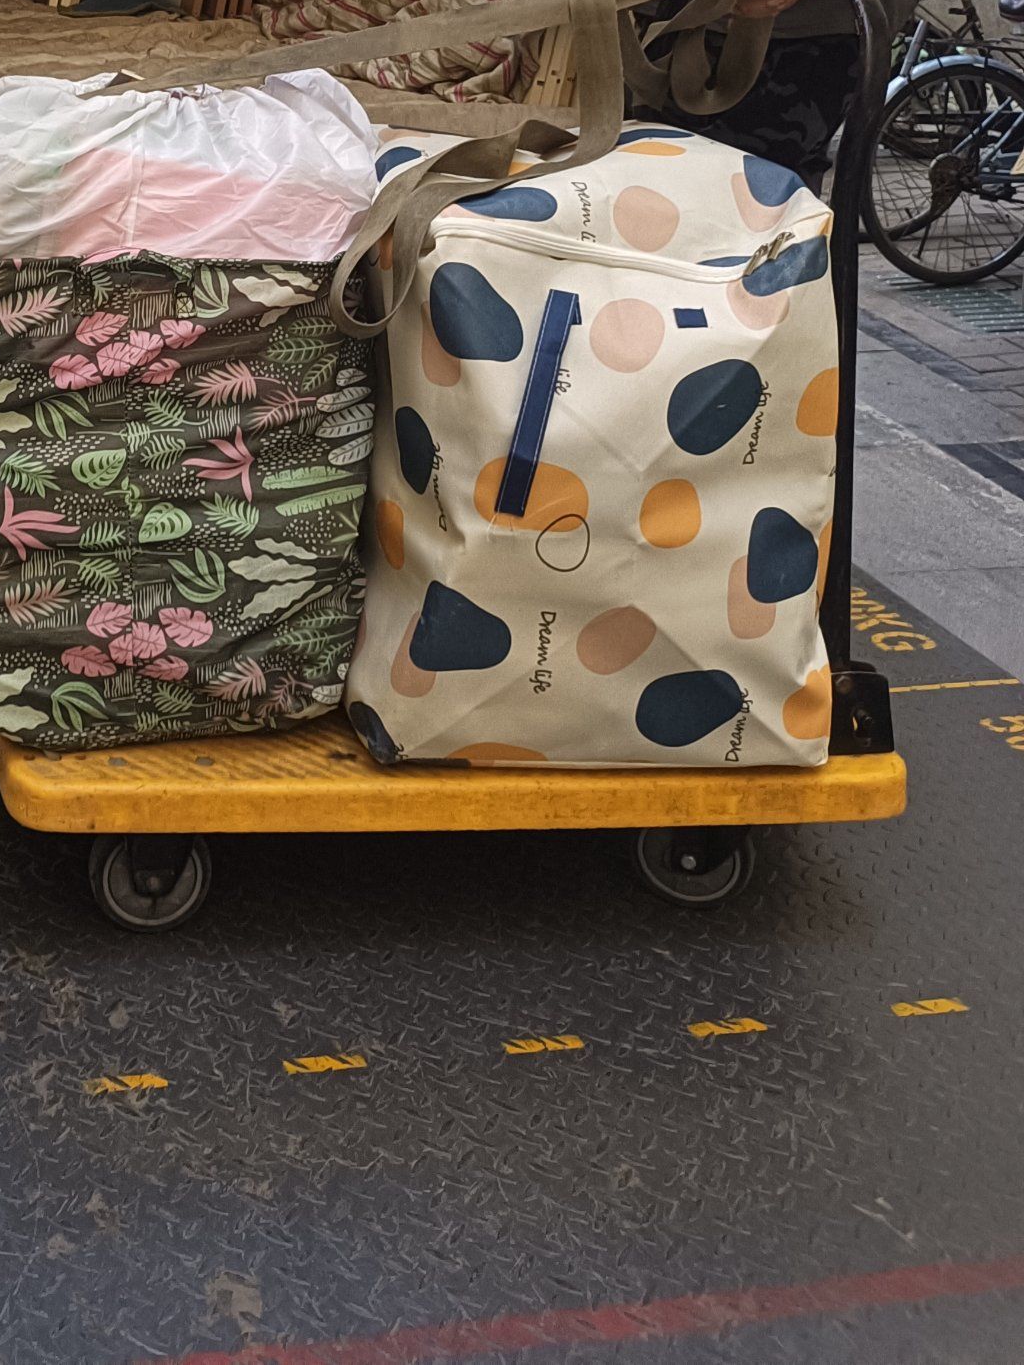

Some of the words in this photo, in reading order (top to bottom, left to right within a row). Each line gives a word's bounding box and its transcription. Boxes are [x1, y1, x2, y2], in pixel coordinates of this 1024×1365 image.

[743, 412, 764, 465] Dream
[537, 611, 557, 666] Dream
[529, 670, 553, 695] life
[725, 716, 747, 762] Dream
